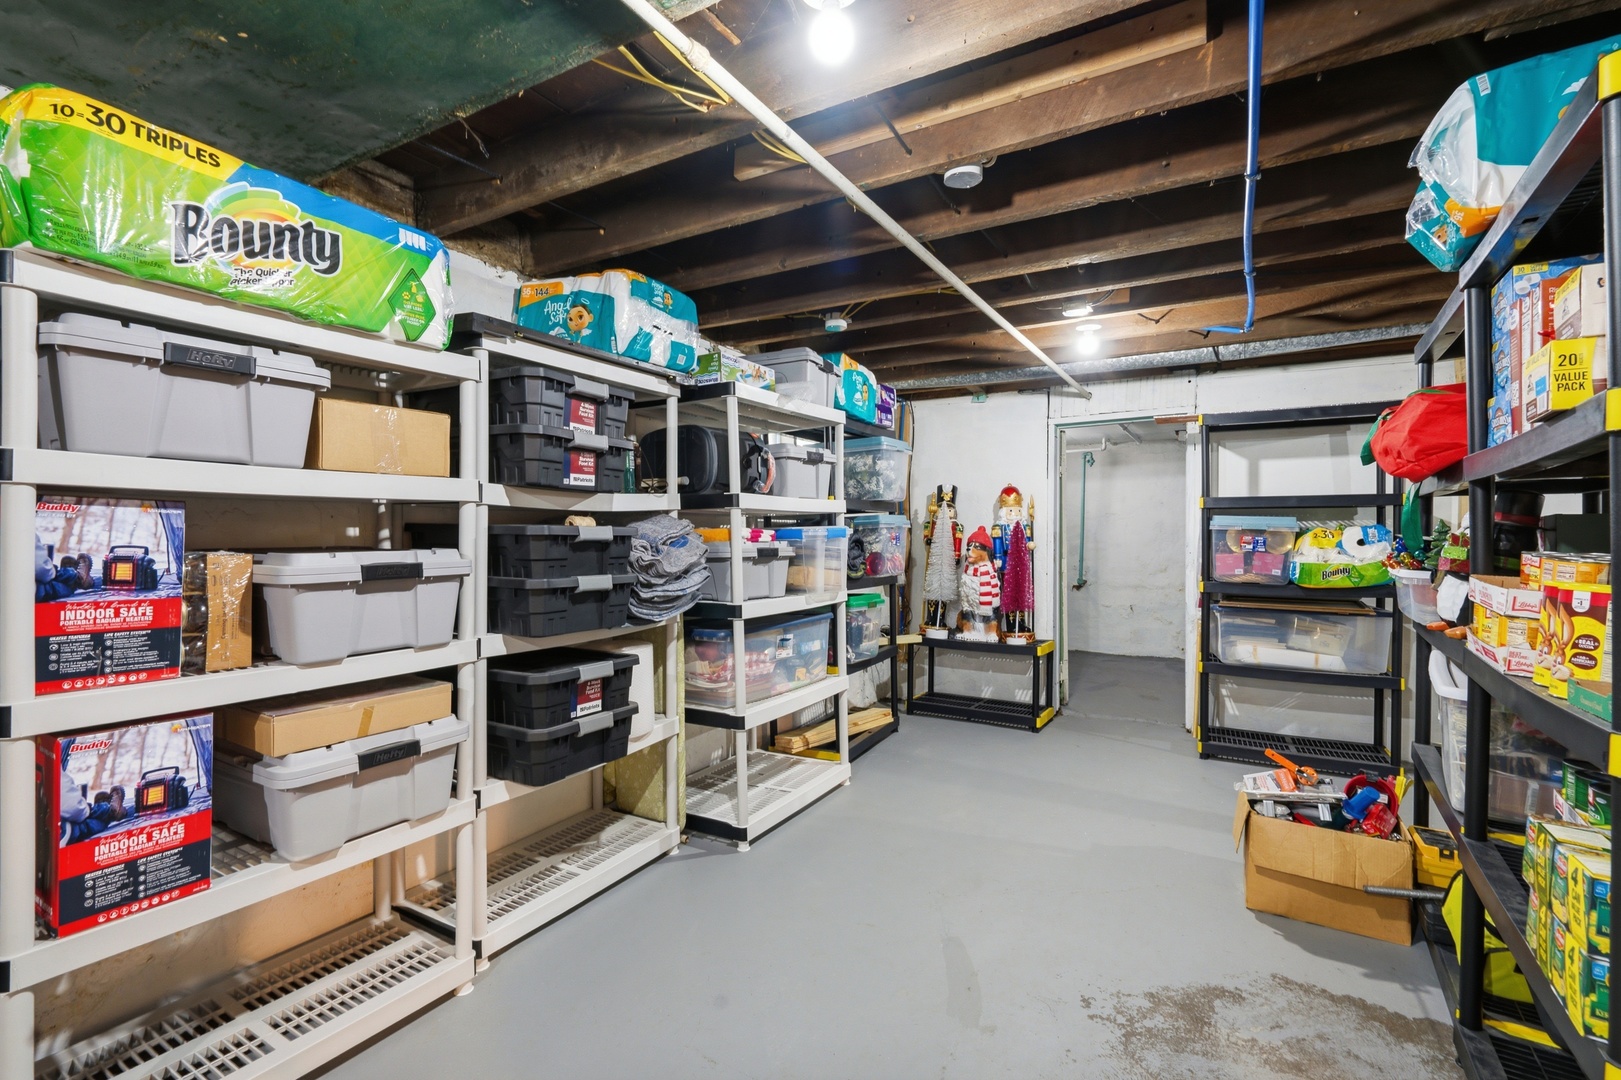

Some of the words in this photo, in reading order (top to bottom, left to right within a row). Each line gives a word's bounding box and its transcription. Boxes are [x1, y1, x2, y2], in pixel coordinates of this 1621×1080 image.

[130, 120, 221, 168] TRIPLES
[171, 203, 341, 275] Bounty
[534, 287, 549, 296] 144
[548, 310, 567, 325] Soft
[190, 350, 233, 367] Hefty
[1558, 353, 1578, 367] 20
[1554, 370, 1588, 382] VALUE
[1556, 381, 1586, 392] PACK
[36, 502, 80, 512] Buddy
[1322, 567, 1350, 580] Bounty
[60, 608, 115, 620] INDOOR
[120, 606, 154, 618] SAFE
[60, 619, 94, 627] PORTABLE
[69, 739, 112, 754] Buddy
[94, 834, 148, 857] INDOOR
[152, 823, 186, 841] SAFE
[94, 848, 128, 863] PORTABLE
[130, 840, 156, 852] RADIANT
[158, 832, 184, 844] HEATERS
[1537, 833, 1545, 852] 4
[1571, 866, 1579, 887] 4
[1540, 905, 1546, 924] 4
[1568, 946, 1575, 966] 4
